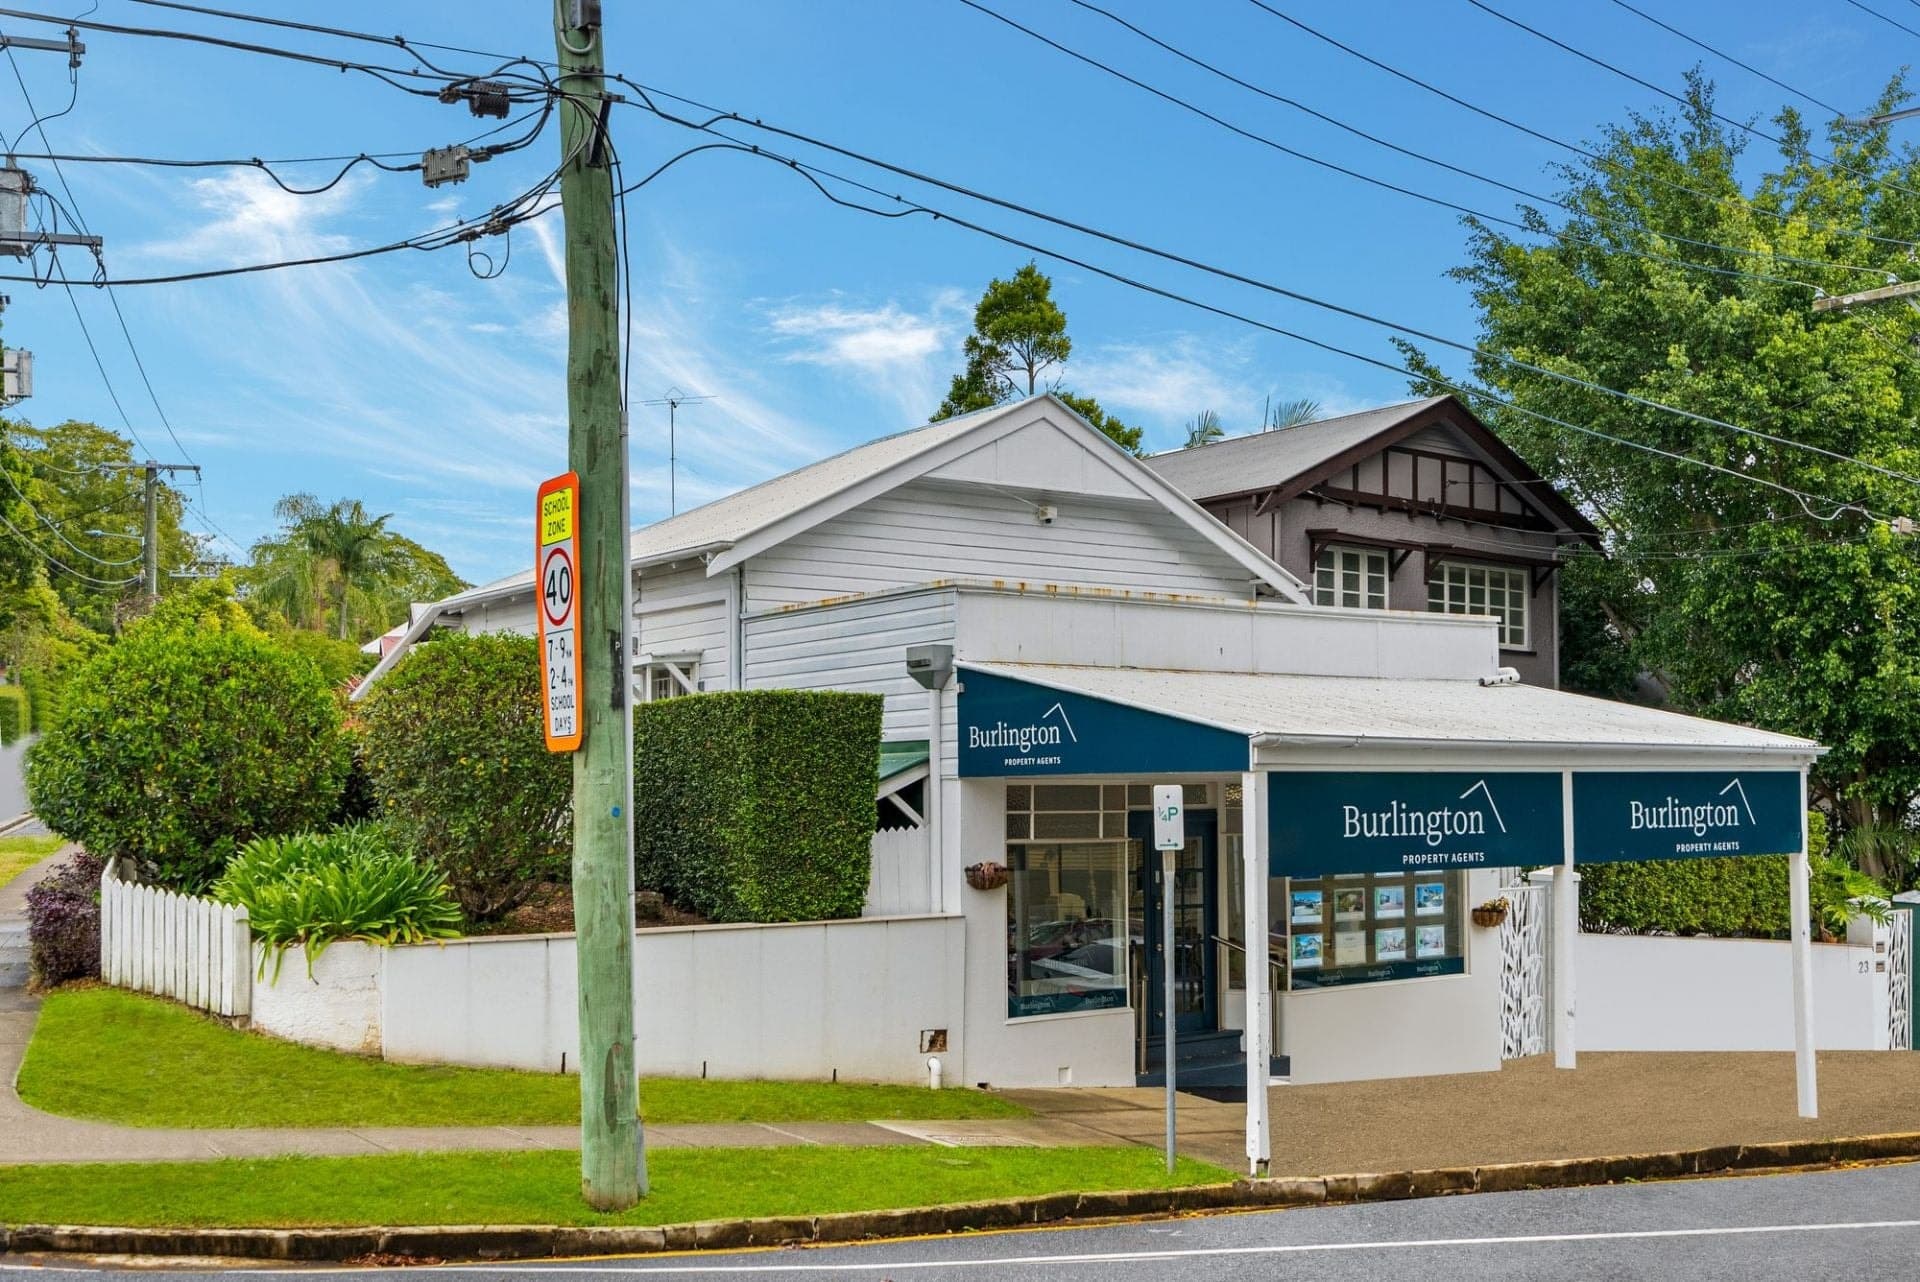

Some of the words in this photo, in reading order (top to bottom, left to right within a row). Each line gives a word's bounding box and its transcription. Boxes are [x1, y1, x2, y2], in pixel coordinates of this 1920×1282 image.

[544, 496, 570, 517] SCHOOL
[548, 518, 565, 537] ZONE
[546, 566, 570, 606] 40
[551, 694, 575, 711] SCHOOL
[555, 716, 572, 734] DAYS
[969, 721, 1061, 753] Burlington
[1004, 758, 1035, 766] PROPERTY
[1037, 756, 1061, 765] AGENTS
[1343, 800, 1485, 846] Burlington
[1630, 797, 1739, 837] Burlington
[1676, 843, 1712, 853] PROPERTY
[1713, 841, 1740, 851] AGENTS
[1403, 853, 1449, 865] PROPERTY
[1451, 852, 1485, 863] AGENTS
[1858, 960, 1869, 974] 23
